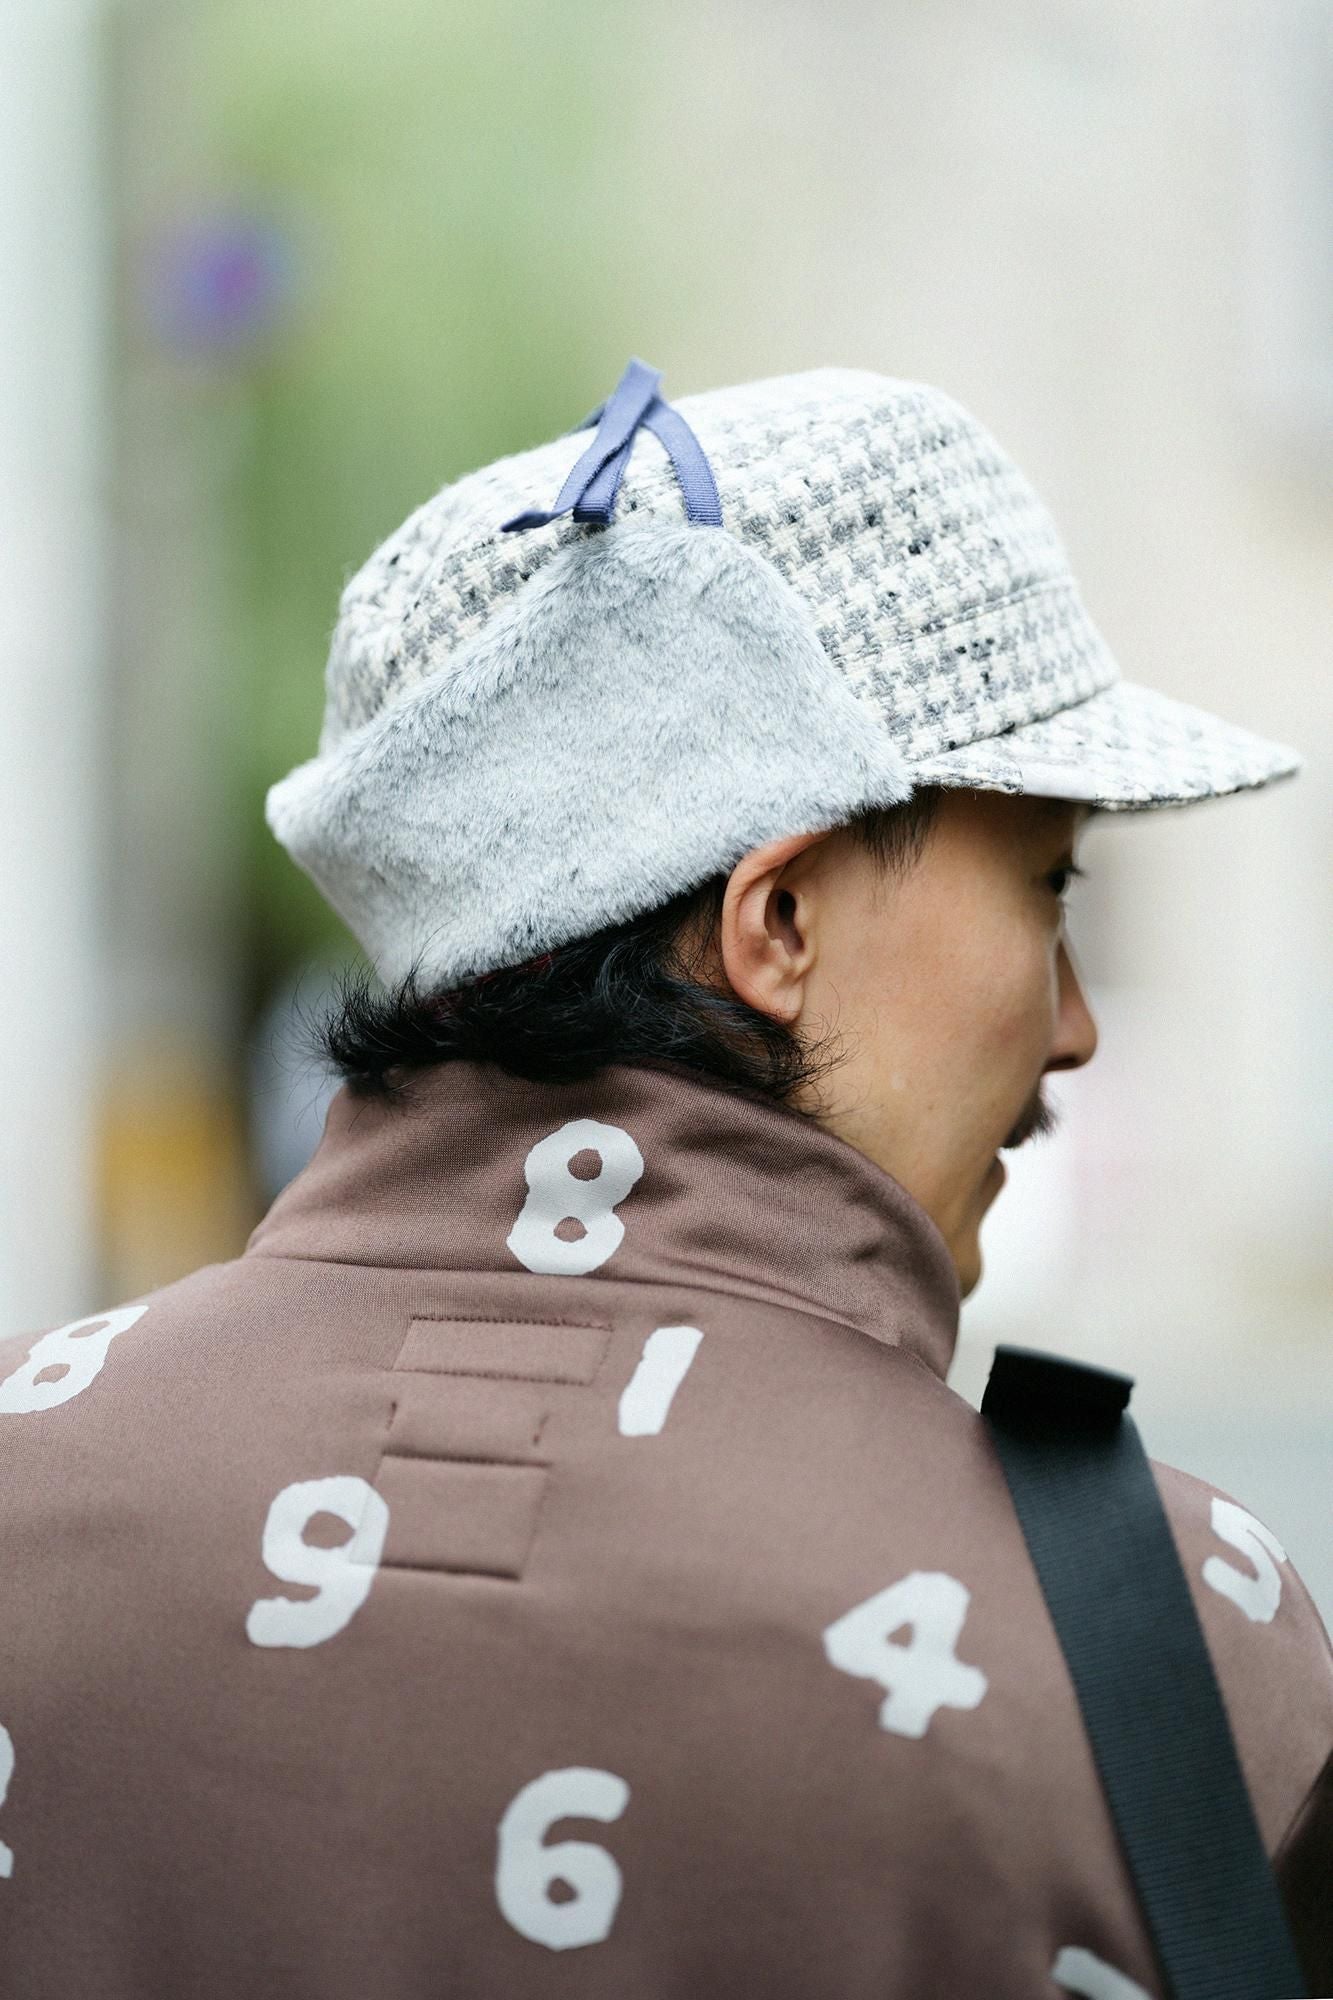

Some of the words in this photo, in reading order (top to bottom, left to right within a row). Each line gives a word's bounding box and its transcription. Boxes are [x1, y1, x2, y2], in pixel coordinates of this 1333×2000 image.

[506, 1118, 645, 1276] 8
[0, 1305, 149, 1414] 8
[617, 1325, 705, 1438] 1
[246, 1475, 391, 1648] 9
[1202, 1497, 1288, 1624] 5
[823, 1570, 989, 1740] 4
[495, 1766, 632, 1951] 6
